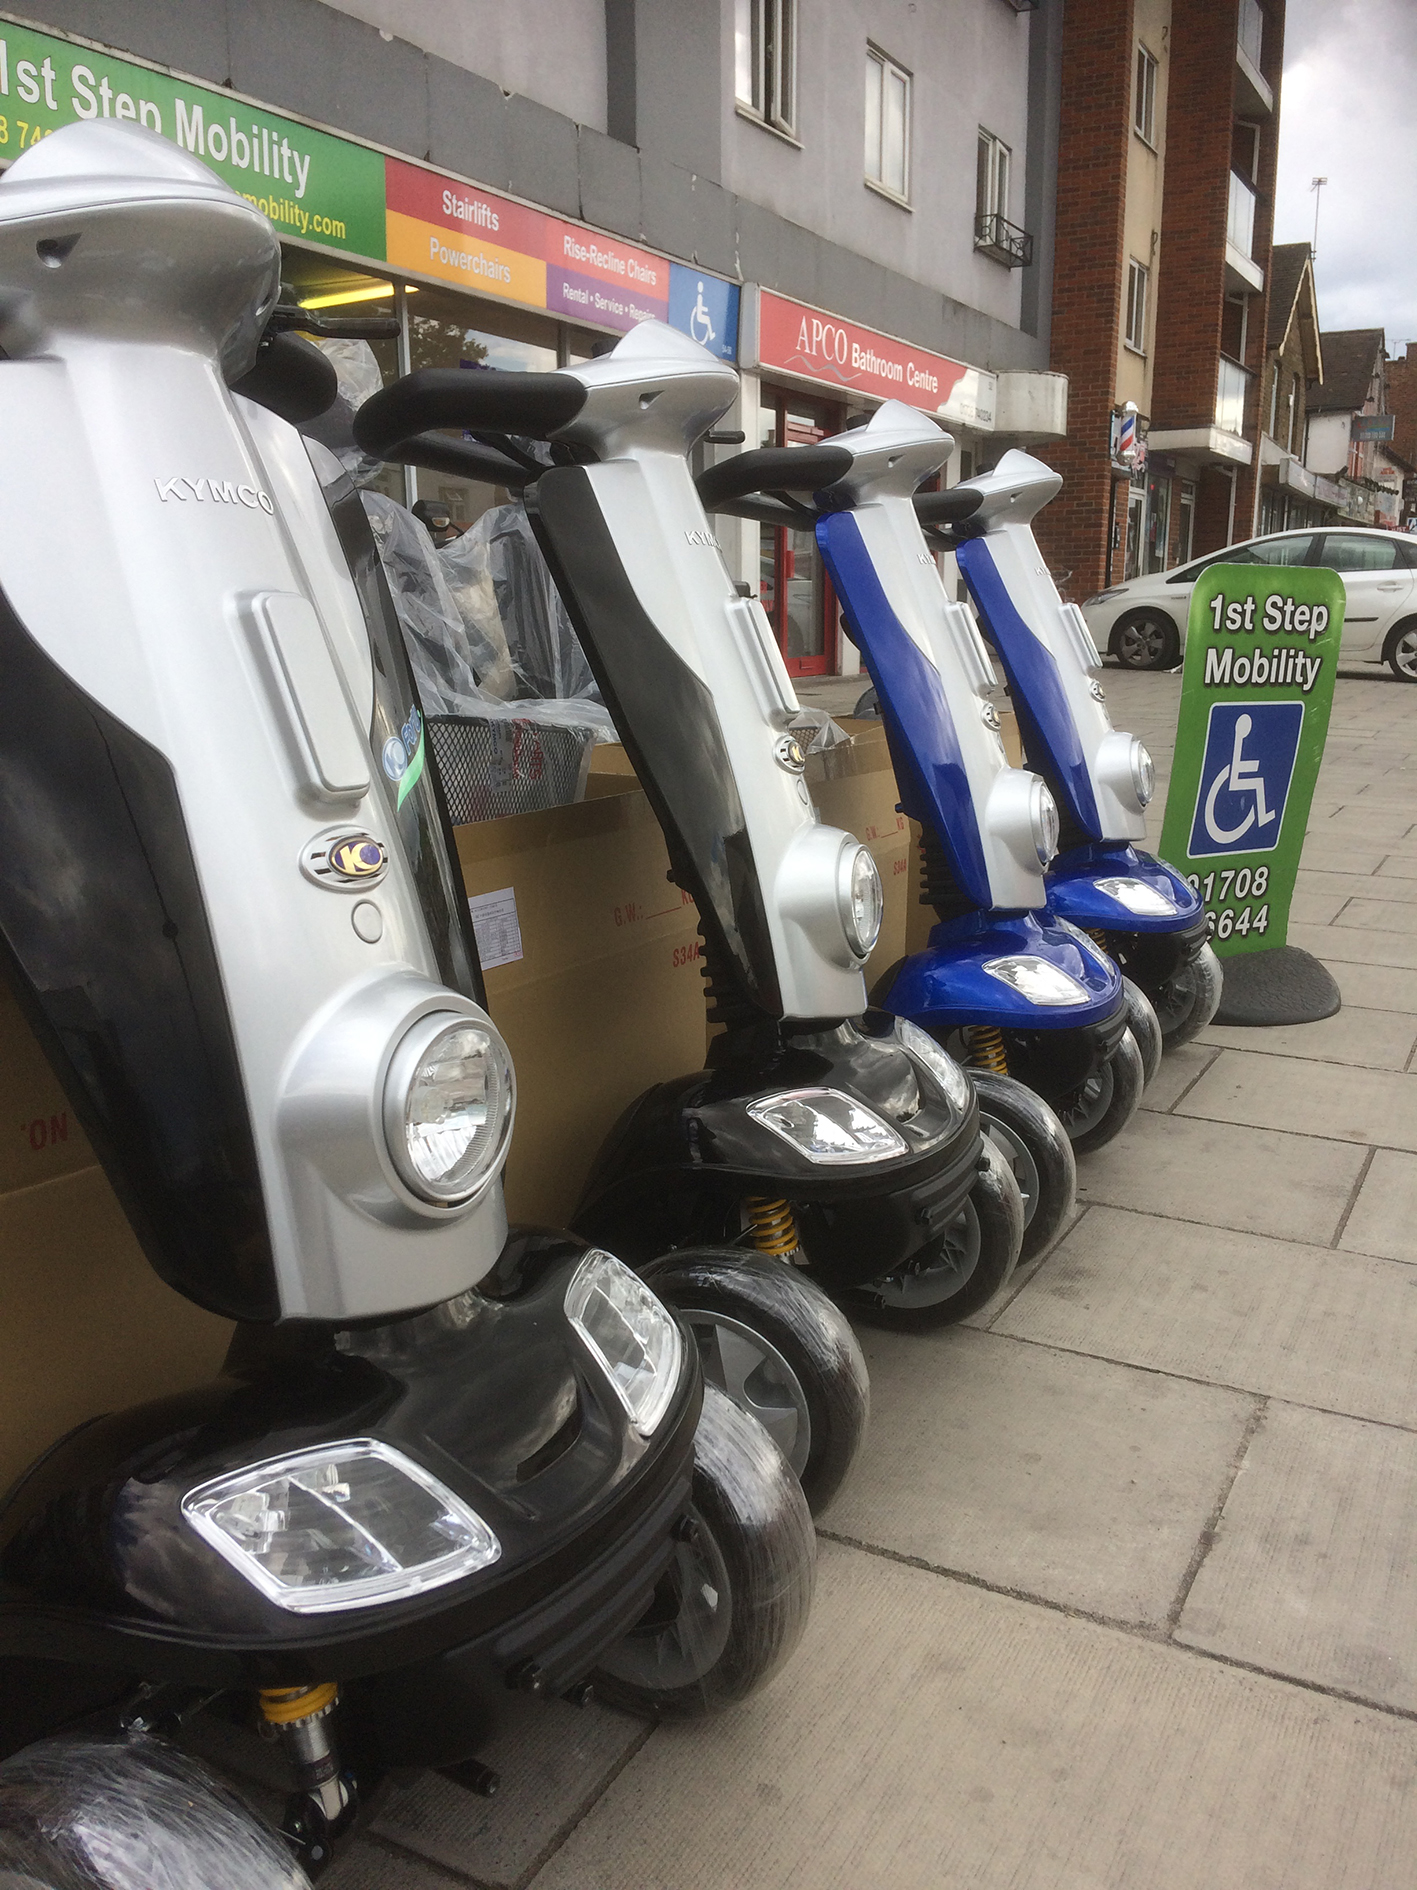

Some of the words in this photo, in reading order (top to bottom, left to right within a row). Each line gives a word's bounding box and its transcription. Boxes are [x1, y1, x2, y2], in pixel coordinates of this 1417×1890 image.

[0, 39, 58, 111] 1st
[175, 98, 310, 199] Mobility
[235, 190, 346, 239] mobility.com
[442, 189, 499, 231] Stairlifts
[430, 236, 511, 283] Powerchairs
[563, 235, 626, 275] Rise-Recline
[627, 258, 657, 286] Chairs
[562, 282, 589, 305] Rental
[594, 292, 624, 315] Service
[796, 315, 848, 365] APCO
[852, 342, 903, 382] Bathroom
[906, 361, 939, 394] Centre
[154, 477, 275, 516] KYMCO
[1210, 594, 1256, 631] 1st
[1262, 594, 1329, 640] Step
[1204, 648, 1322, 691] Mobility
